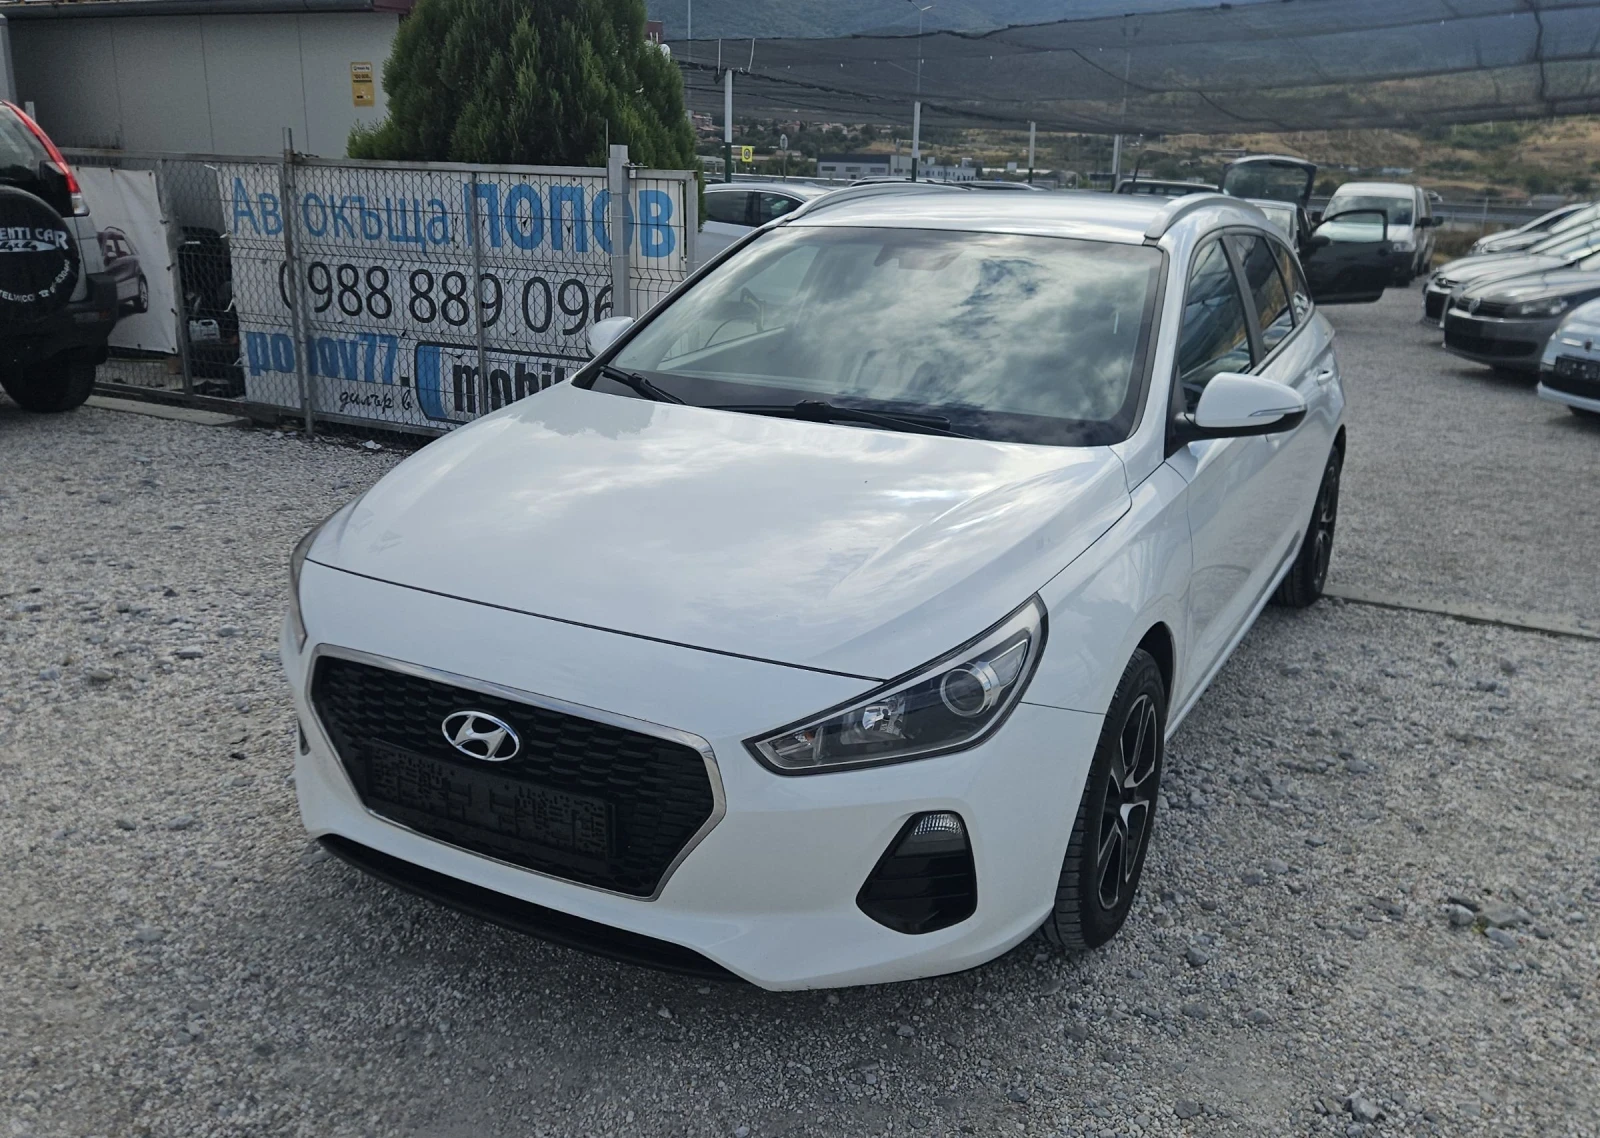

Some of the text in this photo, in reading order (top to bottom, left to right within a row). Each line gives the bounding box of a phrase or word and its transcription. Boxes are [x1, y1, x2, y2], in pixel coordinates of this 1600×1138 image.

[35, 228, 69, 250] CAR
[233, 177, 676, 258] Авокъща ПОПОВ
[409, 268, 503, 329] 889
